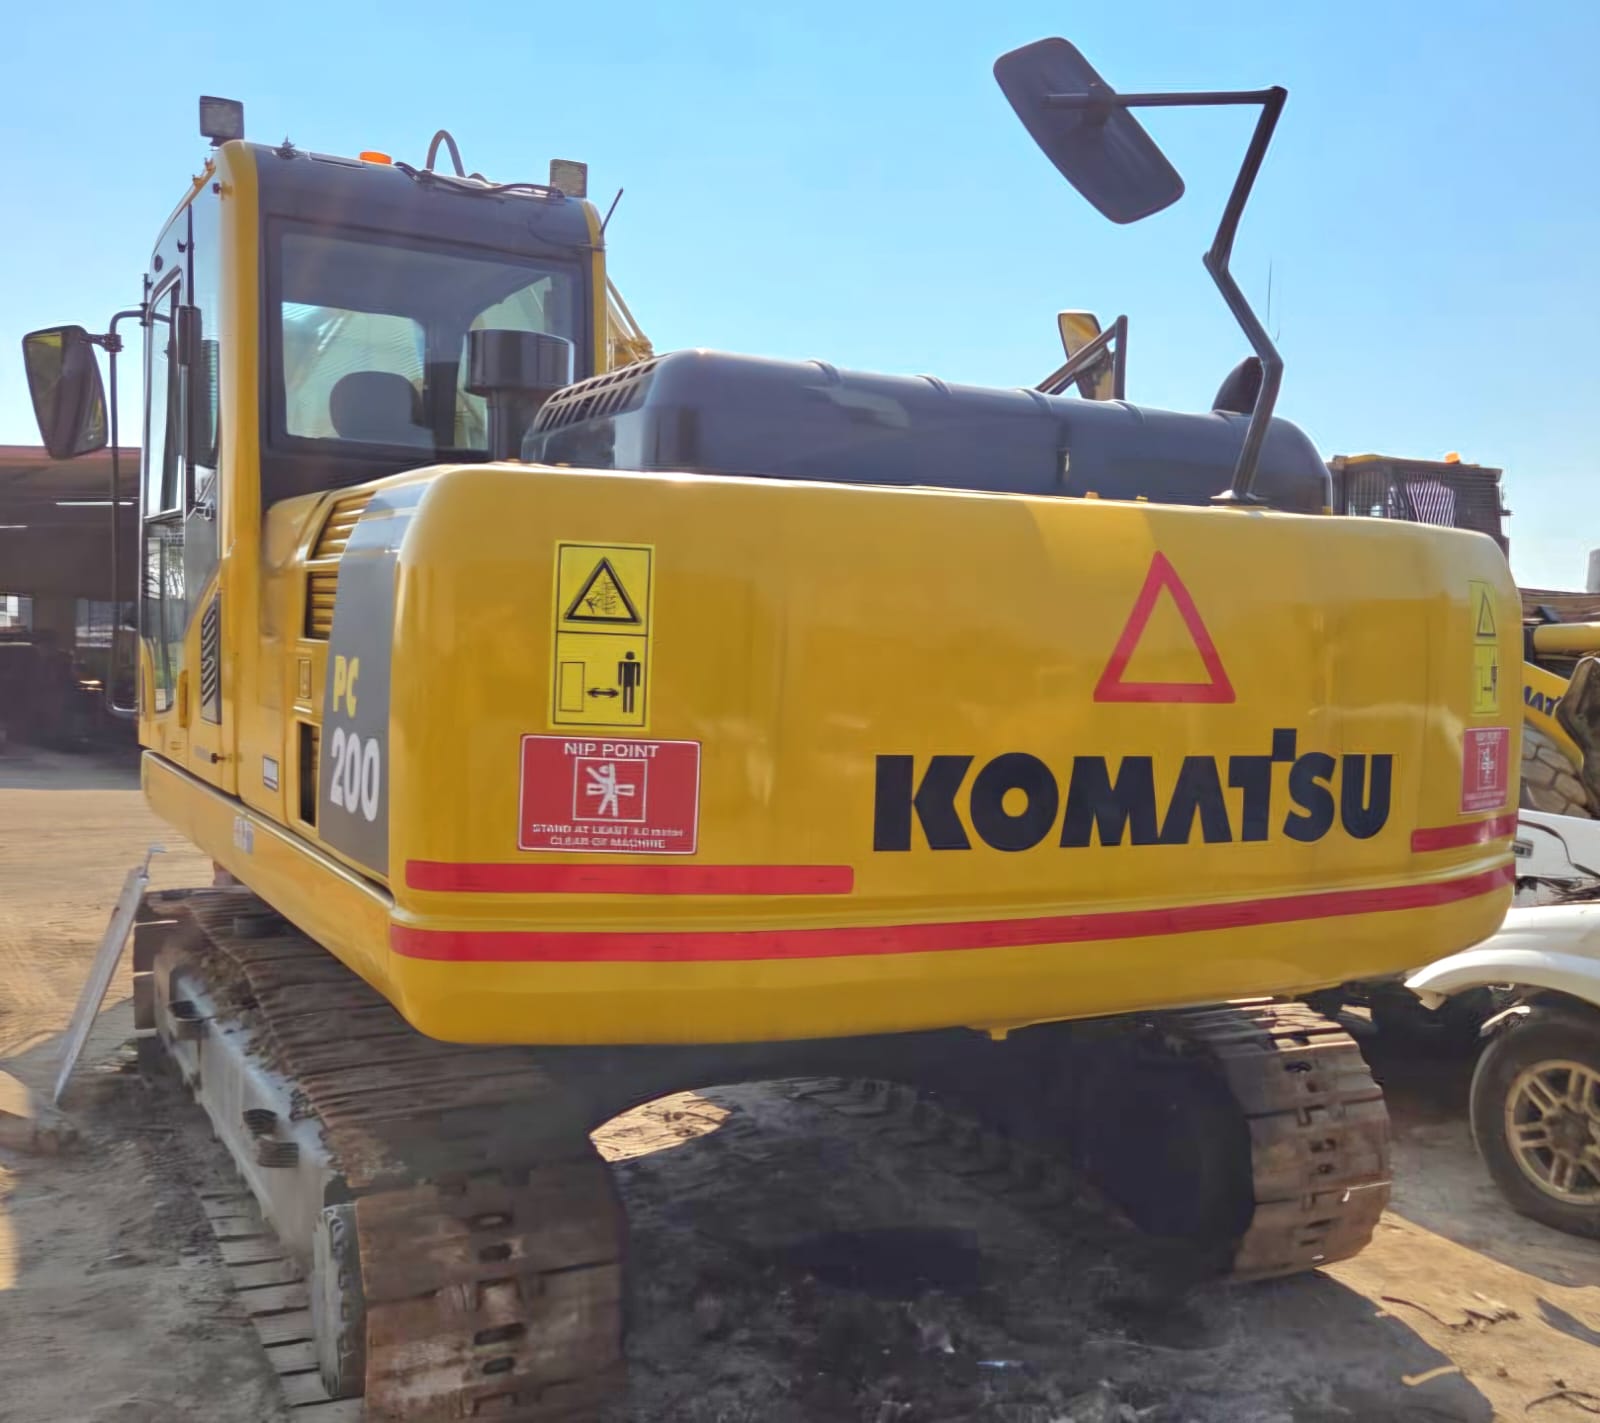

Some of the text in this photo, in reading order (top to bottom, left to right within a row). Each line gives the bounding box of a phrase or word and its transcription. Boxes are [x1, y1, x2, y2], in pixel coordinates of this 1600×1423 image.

[332, 655, 360, 718] PC
[330, 727, 381, 822] 200
[564, 743, 660, 758] NIP POINT
[873, 728, 1393, 852] KOMATSU
